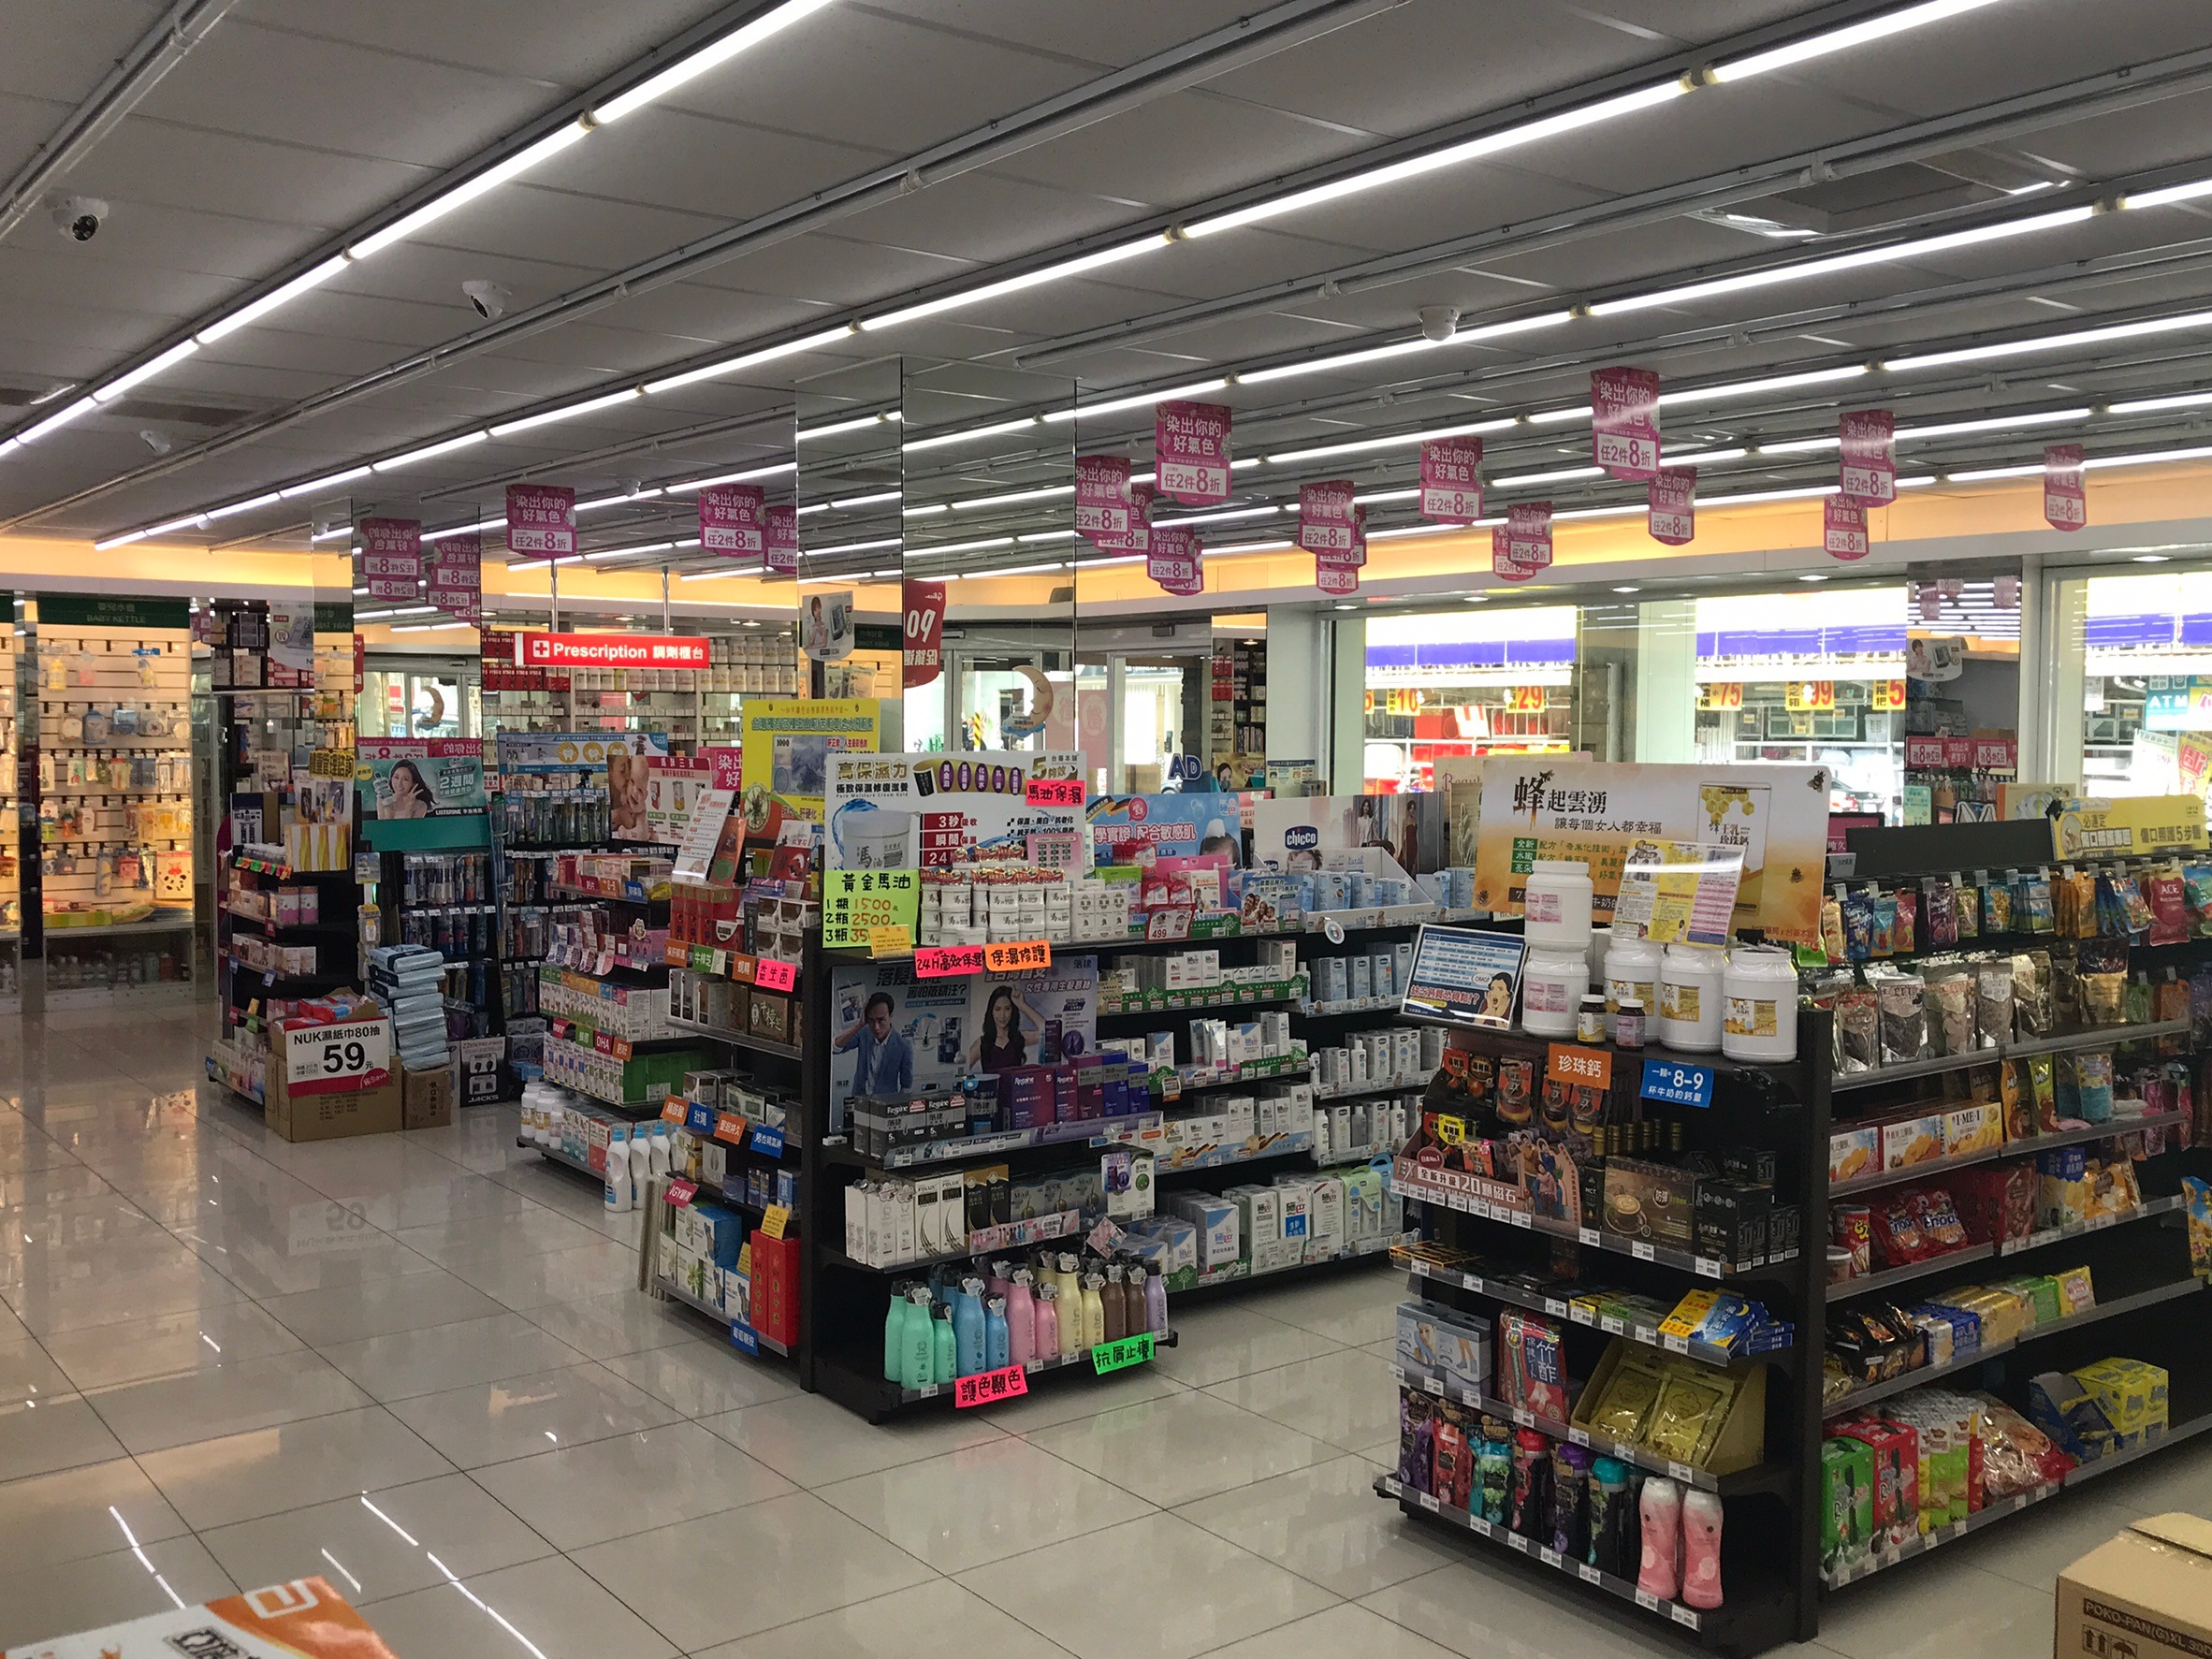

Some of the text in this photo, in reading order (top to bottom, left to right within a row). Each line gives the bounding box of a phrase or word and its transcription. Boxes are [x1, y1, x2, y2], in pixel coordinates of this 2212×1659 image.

[1600, 381, 1650, 404] 染出你的
[1167, 415, 1221, 437] 染出你的
[1173, 435, 1215, 455] 好氣色
[1601, 440, 1650, 467] 任2件8折
[1429, 445, 1475, 465] 染出你的
[1076, 467, 1123, 483] 染出你的
[1164, 468, 1220, 493] 任2件8折
[1435, 465, 1469, 481] 好氣色
[1655, 473, 1689, 490] 染出你的
[1082, 483, 1117, 499] 好氣色
[1846, 472, 1888, 496] 任2件8折
[517, 495, 565, 511] 染出你的
[707, 492, 755, 509] 染出你的
[1307, 488, 1346, 504] 染出你的
[1428, 492, 1474, 515] 任2件8折
[1659, 489, 1684, 505] 好氣色
[523, 510, 560, 523] 好氣色
[715, 507, 750, 522] 好氣色
[1312, 503, 1342, 517] 好氣色
[1834, 508, 1857, 523] 好氣色
[2049, 502, 2080, 520] 任2件8折
[1077, 509, 1122, 530] 任2件8折
[1654, 516, 1687, 536] 任2件8折
[515, 531, 567, 549] 任2件8折
[707, 531, 756, 549] 任2件8折
[1153, 530, 1187, 544] 染出你的
[1304, 529, 1346, 546] 任2件8折
[1829, 533, 1862, 551] 任2件8折
[1157, 543, 1185, 555] 好氣色
[1513, 545, 1547, 561] 任2件8折
[1152, 561, 1188, 577] 任2件8折
[1321, 572, 1353, 589] 任2件8折
[554, 643, 704, 660] Prescription 調劑櫃台
[1518, 686, 1542, 709] 29
[2149, 695, 2188, 708] ATM
[837, 761, 908, 780] 高保濕力
[1168, 753, 1202, 780] AD
[1513, 773, 1607, 823] 蜂起雲湧
[939, 815, 959, 828] 3秒
[1555, 817, 1662, 835] 讓每個女人都幸福
[936, 834, 959, 846] 瞬間
[1287, 827, 1317, 846] chicco
[929, 852, 947, 865] 24
[842, 873, 910, 892] 黃金馬油
[2161, 884, 2179, 895] ACE
[854, 898, 891, 911] 1500
[851, 913, 891, 925] 2500
[851, 928, 871, 944] 35
[1152, 928, 1167, 939] 499
[596, 1035, 610, 1050] DHA
[324, 1041, 365, 1073] 59
[1558, 1055, 1602, 1078] 珍珠鈣
[1673, 1069, 1704, 1090] 8-9
[468, 1094, 499, 1103] JACKS
[1648, 1085, 1703, 1104] 杯牛奶的鈣量
[1420, 1167, 1458, 1186] 全新升級
